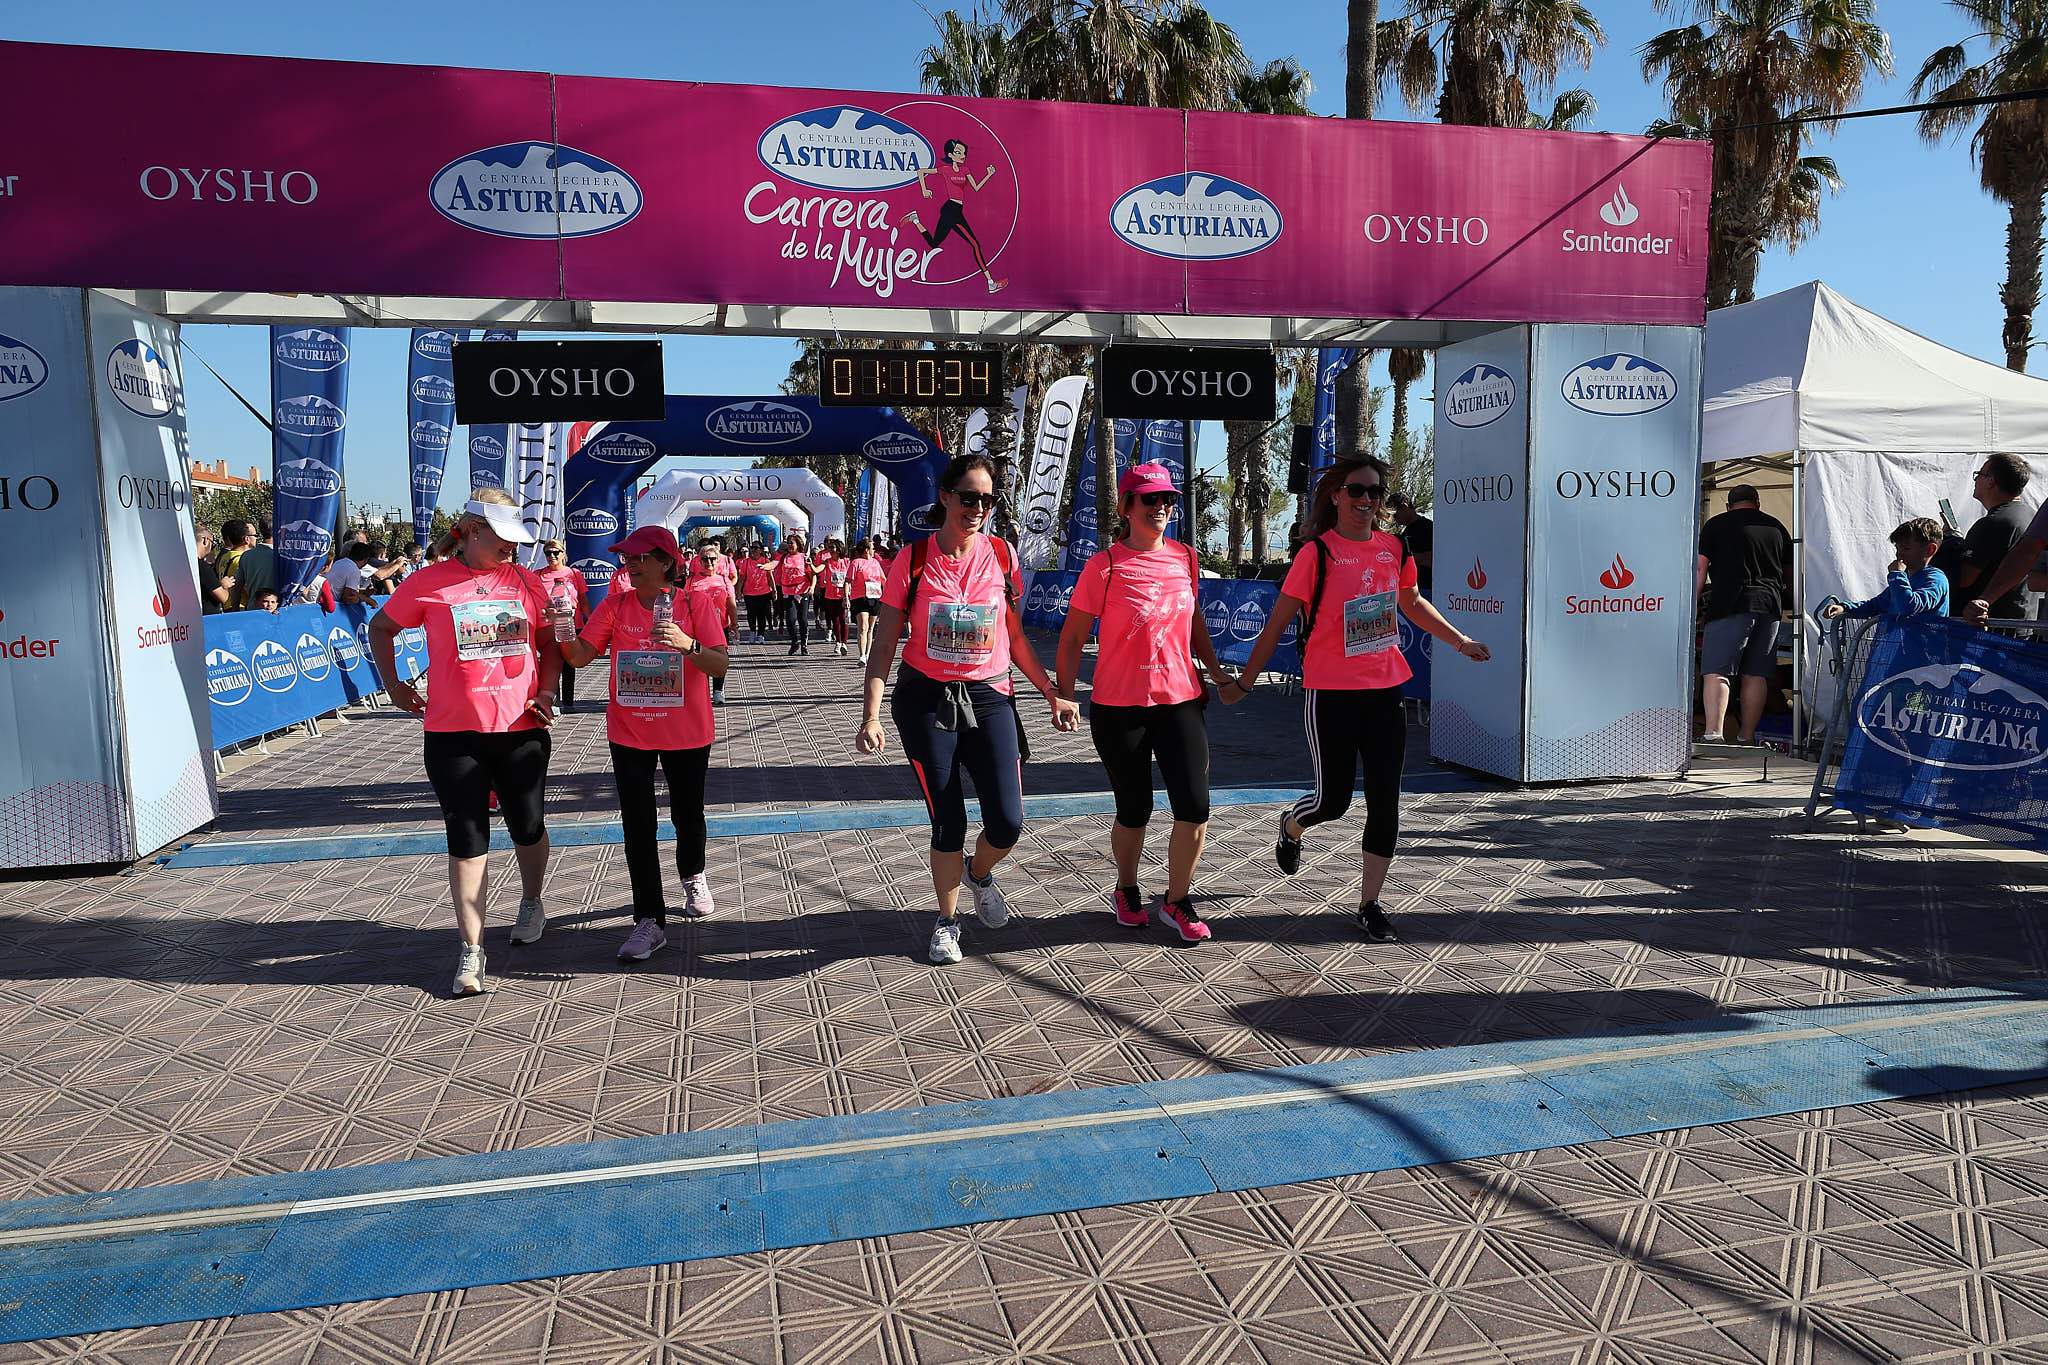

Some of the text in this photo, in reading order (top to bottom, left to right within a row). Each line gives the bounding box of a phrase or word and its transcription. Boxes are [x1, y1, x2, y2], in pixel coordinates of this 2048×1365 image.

[772, 133, 920, 172] ASTURIANA
[799, 133, 916, 147] CENTRAL LECHERA
[139, 165, 318, 205] OYSHO
[479, 174, 546, 184] CENTRAL
[447, 174, 627, 214] ASTURIANA
[744, 181, 890, 230] Carrera
[1150, 201, 1264, 214] CENTRAL LECHERA
[1124, 201, 1270, 238] ASTURIANA
[1363, 214, 1489, 246] OYSHO
[1562, 229, 1674, 255] Santander
[781, 226, 944, 298] de la Mujer
[418, 340, 452, 355] ASTURIA
[114, 360, 173, 404] ASTURIANA
[489, 367, 635, 397] OYSHO
[832, 359, 989, 396] 01:10:34
[1130, 368, 1252, 398] OYSHO
[1570, 376, 1668, 400] ASTURIANA
[1448, 389, 1510, 416] ASTURIANA
[714, 414, 804, 434] ASTURIANA
[1150, 428, 1182, 441] ASTURIA
[592, 444, 650, 456] ASTURIANA
[870, 444, 924, 456] ASTURIANA
[1025, 400, 1074, 534] OYSHO
[118, 474, 184, 512] OYSHO
[699, 474, 782, 492] OYSHO
[1444, 473, 1514, 504] OYSHO
[1556, 470, 1676, 499] OYSHO
[568, 518, 614, 530] ASTURIANA
[1448, 594, 1504, 614] Santander
[1566, 594, 1664, 614] Santander
[137, 622, 190, 650] Santander
[1868, 692, 2040, 754] ASTURIANA
[1973, 702, 2041, 721] LECHERA
